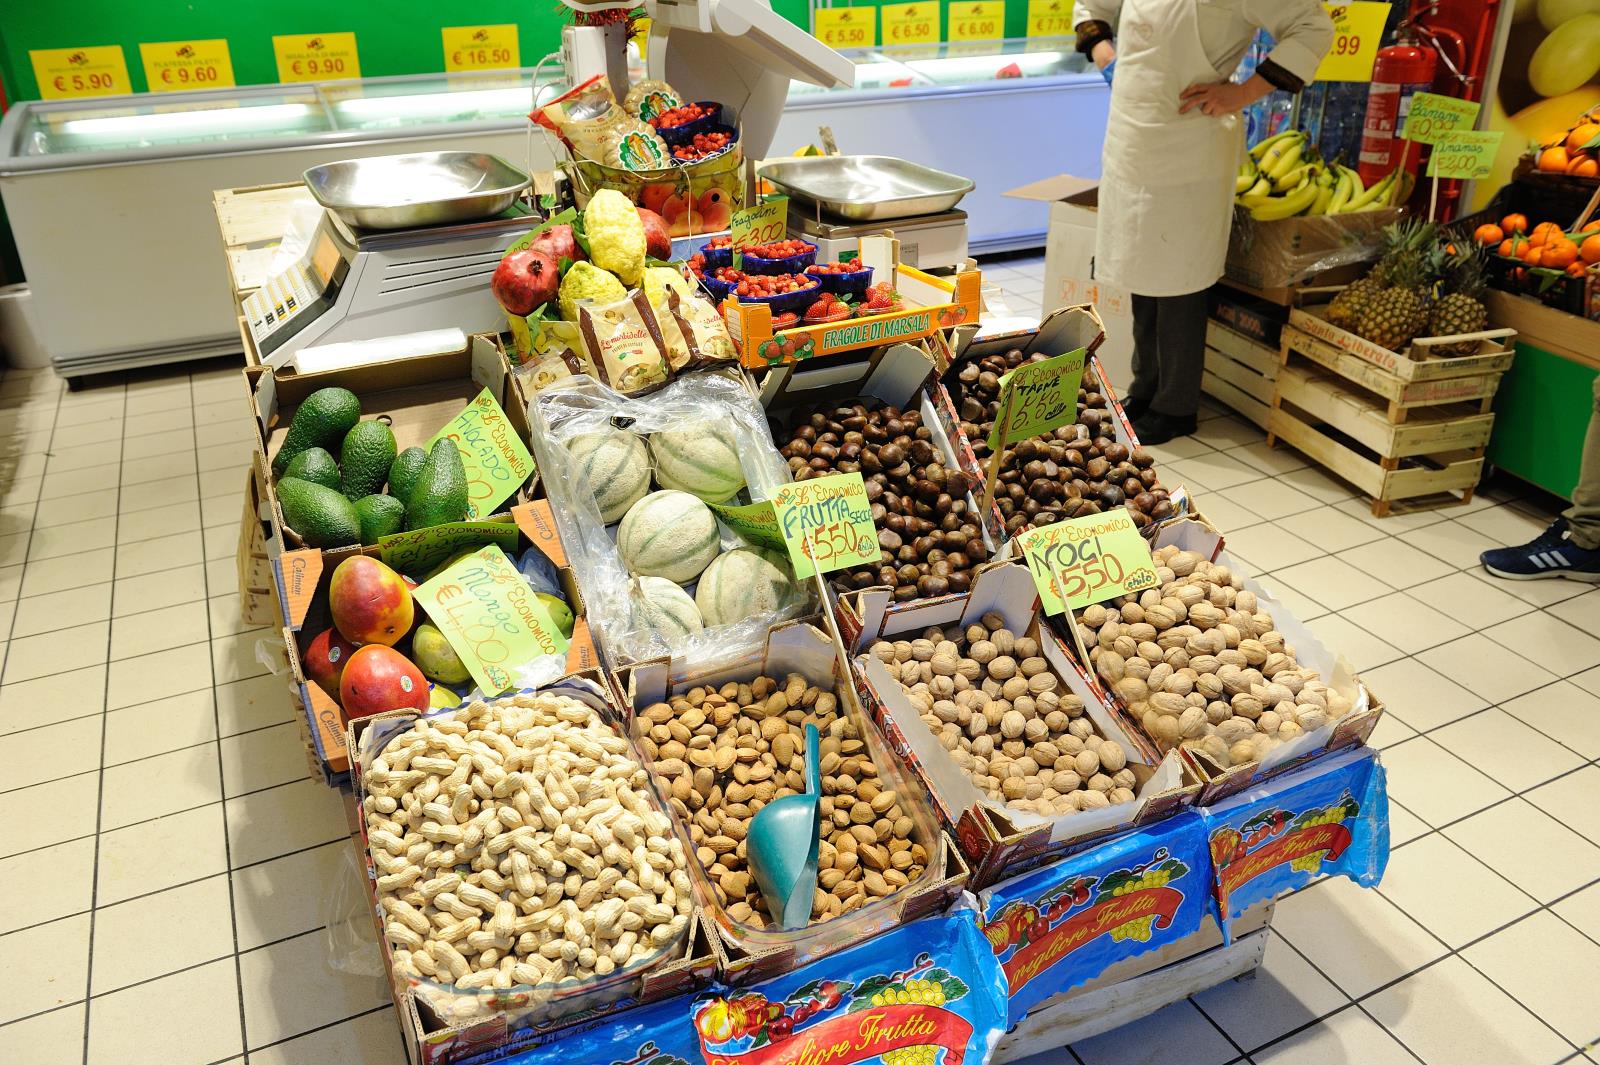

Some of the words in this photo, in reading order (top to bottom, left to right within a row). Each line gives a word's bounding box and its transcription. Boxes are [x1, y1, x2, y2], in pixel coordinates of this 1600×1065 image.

[825, 31, 834, 43] €
[837, 29, 865, 42] 5.50
[892, 26, 900, 38] €
[904, 23, 930, 37] 6.50
[958, 23, 966, 35] €
[969, 21, 994, 34] 6.00
[1037, 19, 1044, 30] €
[292, 60, 303, 75] €
[307, 58, 345, 75] 9.90
[453, 51, 463, 65] €
[468, 49, 511, 64] 16.50
[53, 75, 67, 92] €
[72, 73, 113, 91] 5.90
[161, 68, 174, 84] €
[178, 66, 218, 83] 9.60
[823, 324, 870, 350] FRAGOLE
[870, 321, 883, 341] DI
[884, 313, 931, 338] MARSALA
[1305, 318, 1335, 340] Santa
[1337, 335, 1396, 369] Liberata
[455, 409, 510, 481] AVOCADO
[481, 409, 527, 479] L'Economico
[794, 482, 864, 508] L'Economico
[783, 496, 850, 540] FRUTTA
[410, 526, 514, 545] L'Economico
[1044, 519, 1130, 550] L'Economico
[1031, 536, 1103, 578] NOCI
[458, 567, 520, 634] Mango
[490, 567, 557, 655] L'Economico
[1277, 831, 1334, 861] Frutta
[1010, 927, 1089, 988] migliore
[1091, 895, 1158, 932] Frutta
[854, 1013, 938, 1051] Frutta
